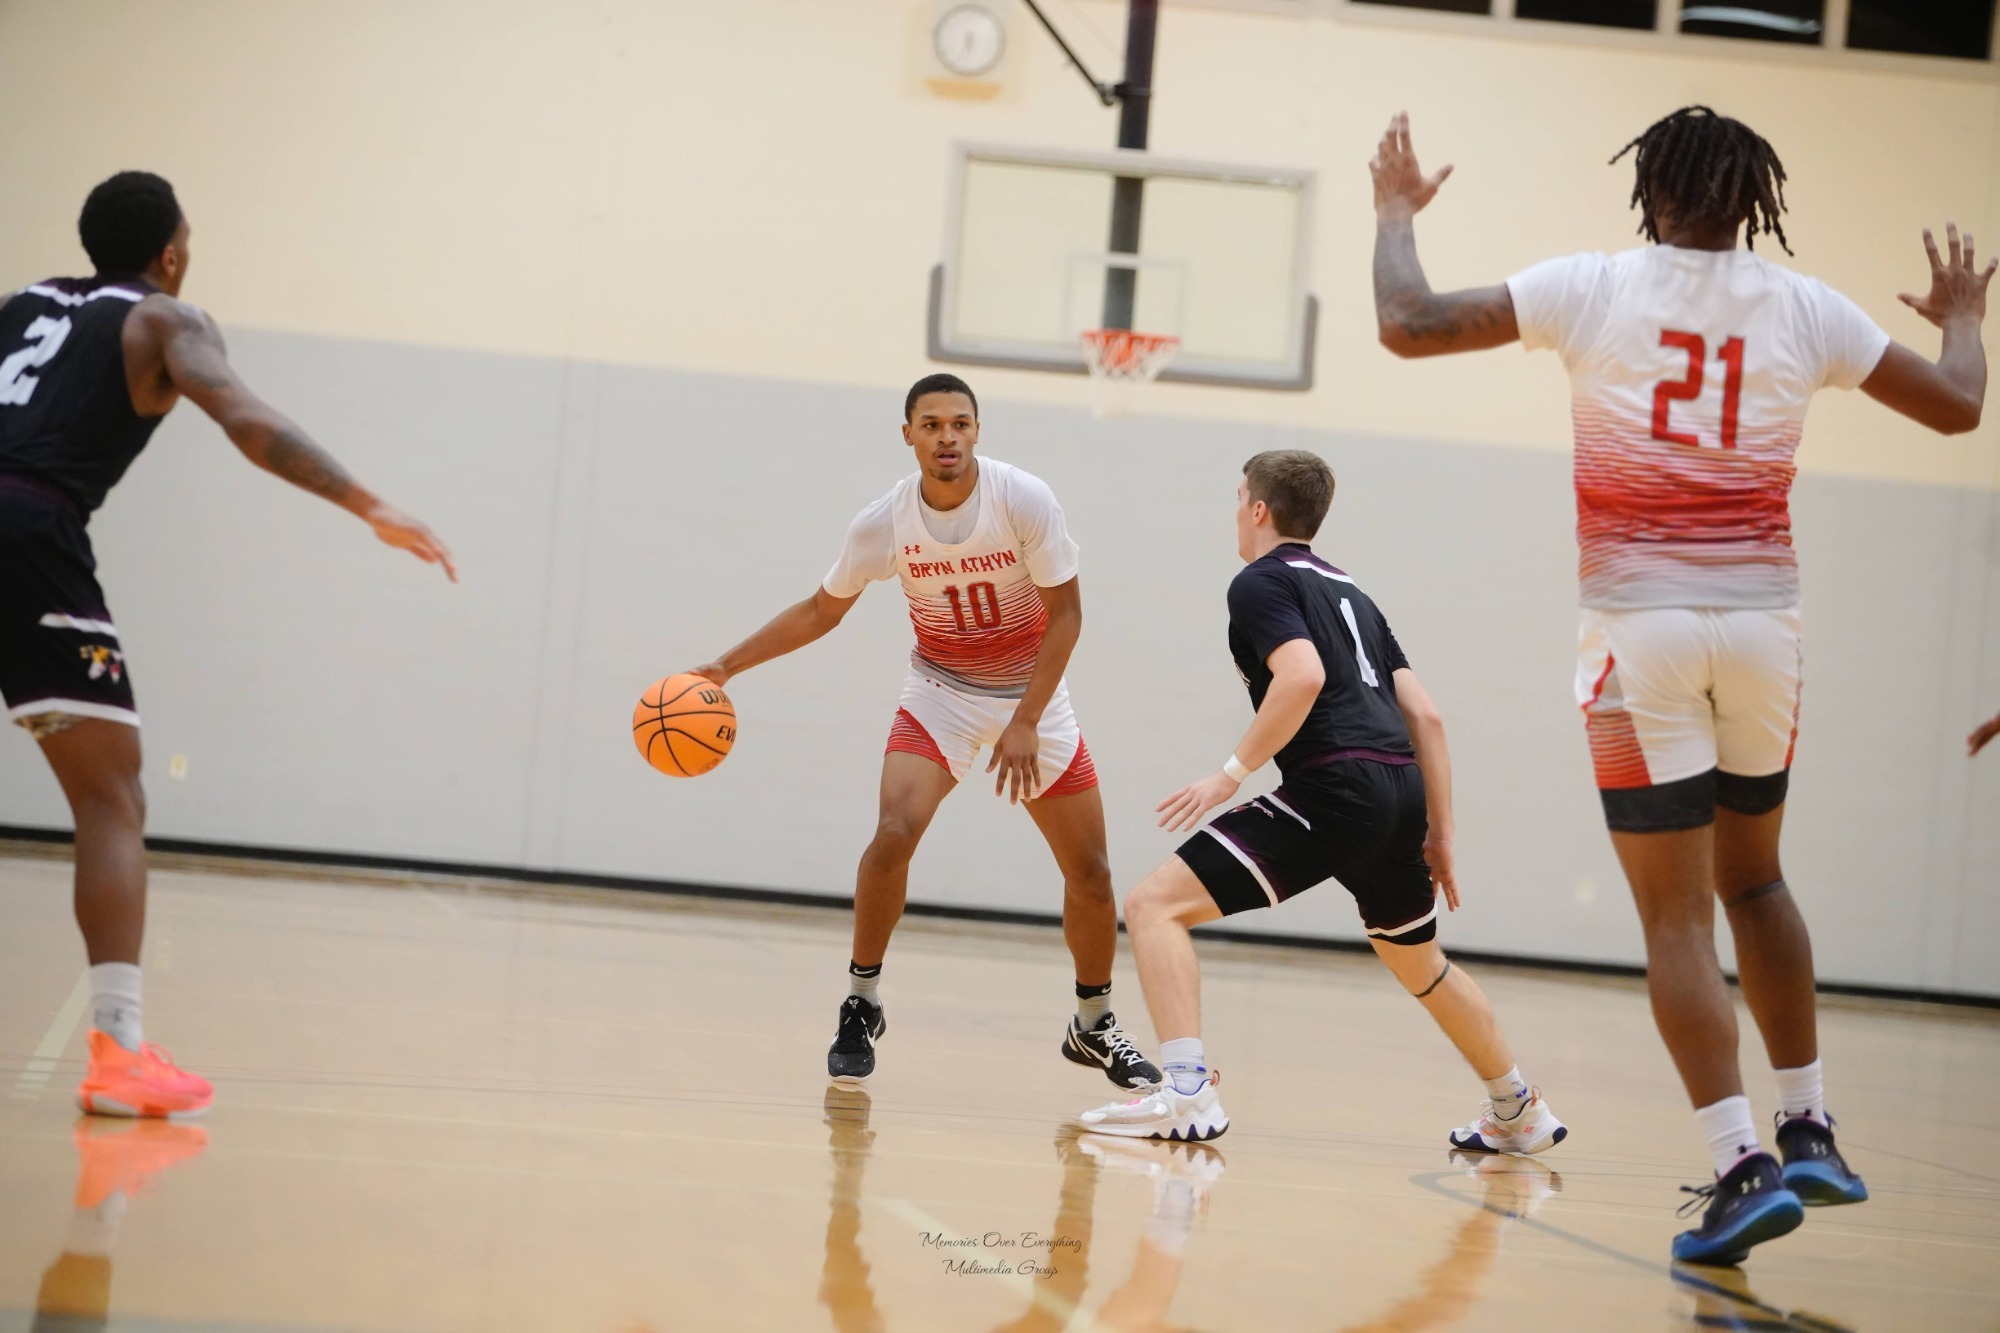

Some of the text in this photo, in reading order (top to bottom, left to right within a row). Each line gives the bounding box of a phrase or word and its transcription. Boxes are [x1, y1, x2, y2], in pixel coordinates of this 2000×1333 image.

[0, 314, 72, 406] 2
[1651, 327, 1745, 450] 21
[908, 549, 1017, 579] BRYN ATHYN
[942, 580, 1003, 633] 10
[1339, 597, 1379, 688] 1
